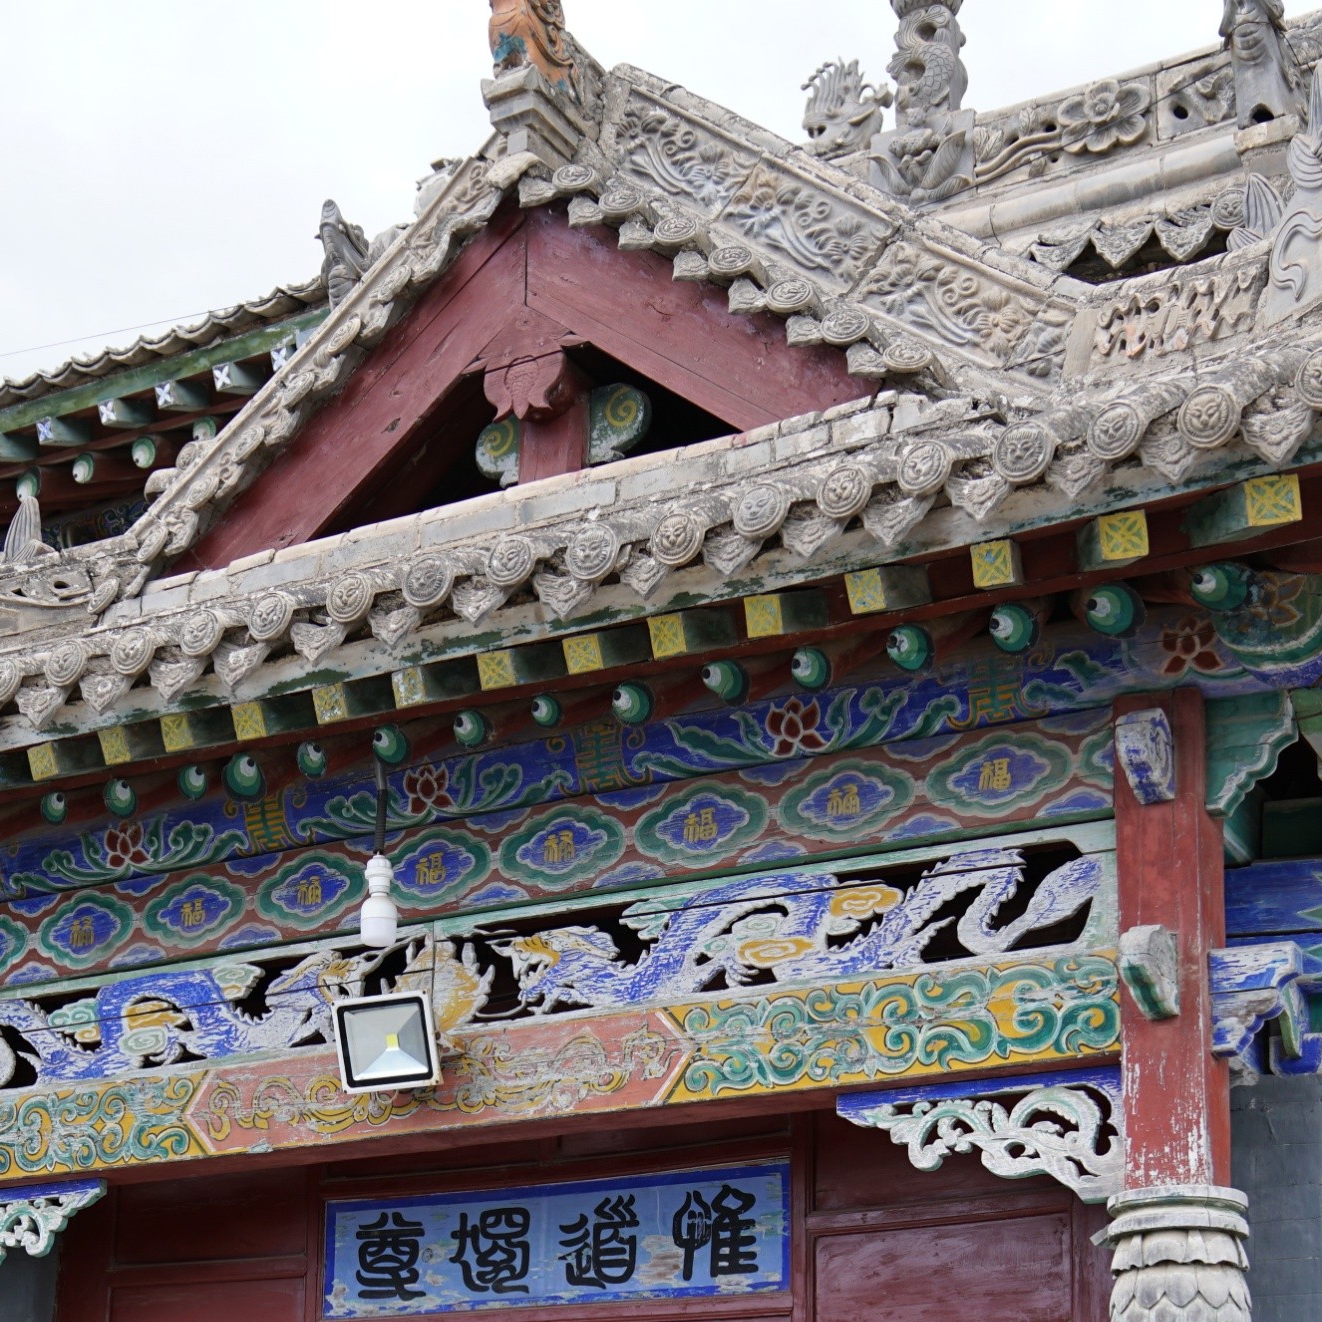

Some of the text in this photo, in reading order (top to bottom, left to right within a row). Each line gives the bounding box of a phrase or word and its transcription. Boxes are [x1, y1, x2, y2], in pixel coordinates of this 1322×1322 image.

[180, 898, 206, 926] 福
[416, 852, 446, 885] 福
[684, 808, 718, 843] 福
[978, 758, 1012, 792] 福
